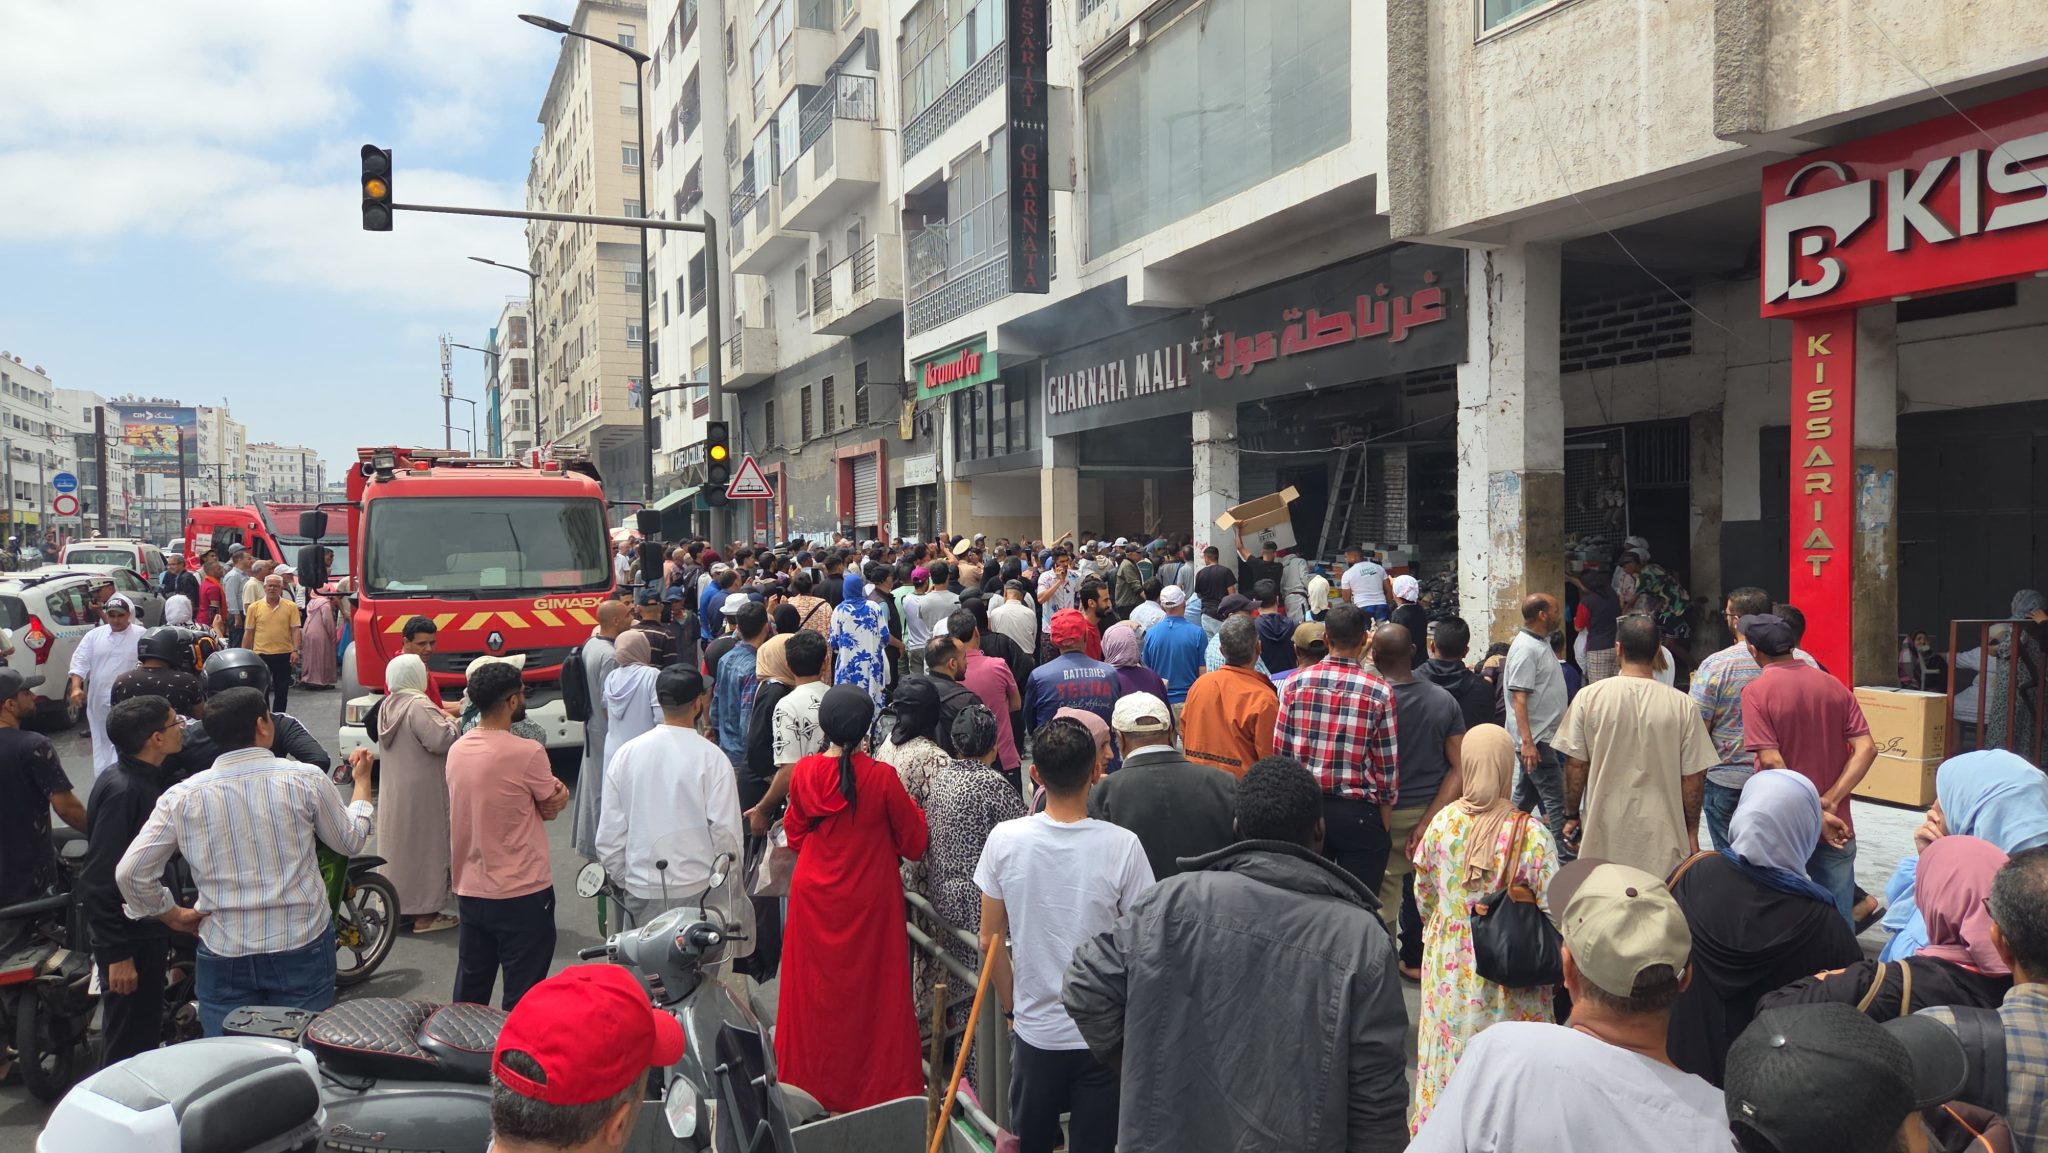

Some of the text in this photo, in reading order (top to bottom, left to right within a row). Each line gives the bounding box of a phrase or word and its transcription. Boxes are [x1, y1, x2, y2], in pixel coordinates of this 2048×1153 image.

[1020, 143, 1038, 288] GHARNATA
[1215, 269, 1445, 380] غرناطة مول
[1047, 343, 1190, 415] GHARNATA MALL
[1802, 333, 1835, 577] KISSARIAT
[533, 596, 604, 610] GIMAEX
[1063, 667, 1106, 681] BATTERIES
